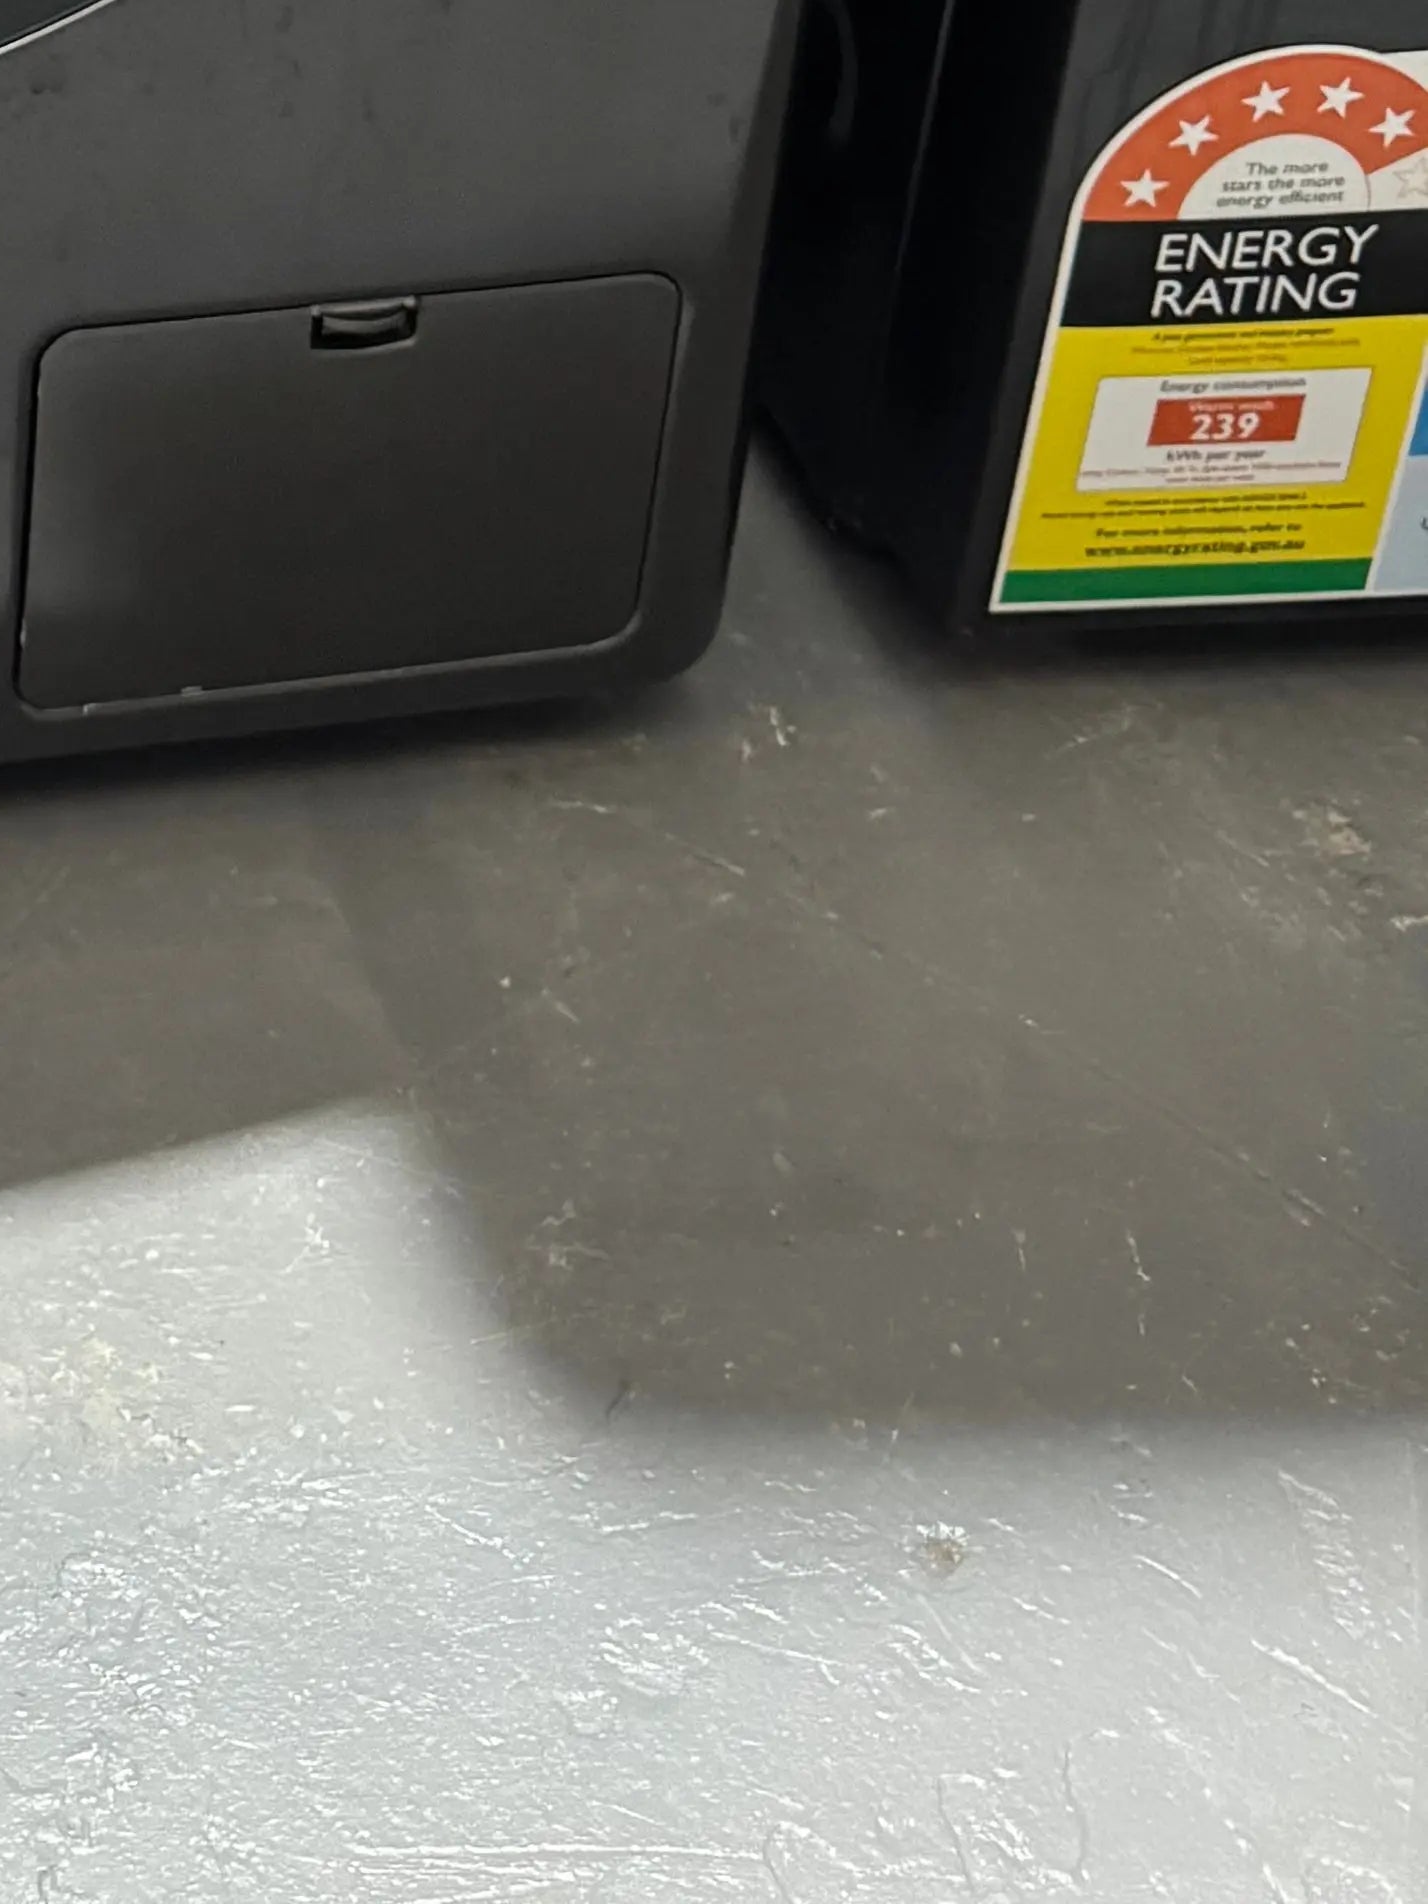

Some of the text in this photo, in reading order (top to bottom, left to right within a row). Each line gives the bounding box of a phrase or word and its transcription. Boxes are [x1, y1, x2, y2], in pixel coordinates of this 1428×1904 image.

[1246, 160, 1328, 176] The more
[1223, 175, 1345, 192] stars the more
[1155, 225, 1379, 273] ENERGY
[1150, 271, 1360, 318] RATING
[1189, 412, 1261, 441] 239
